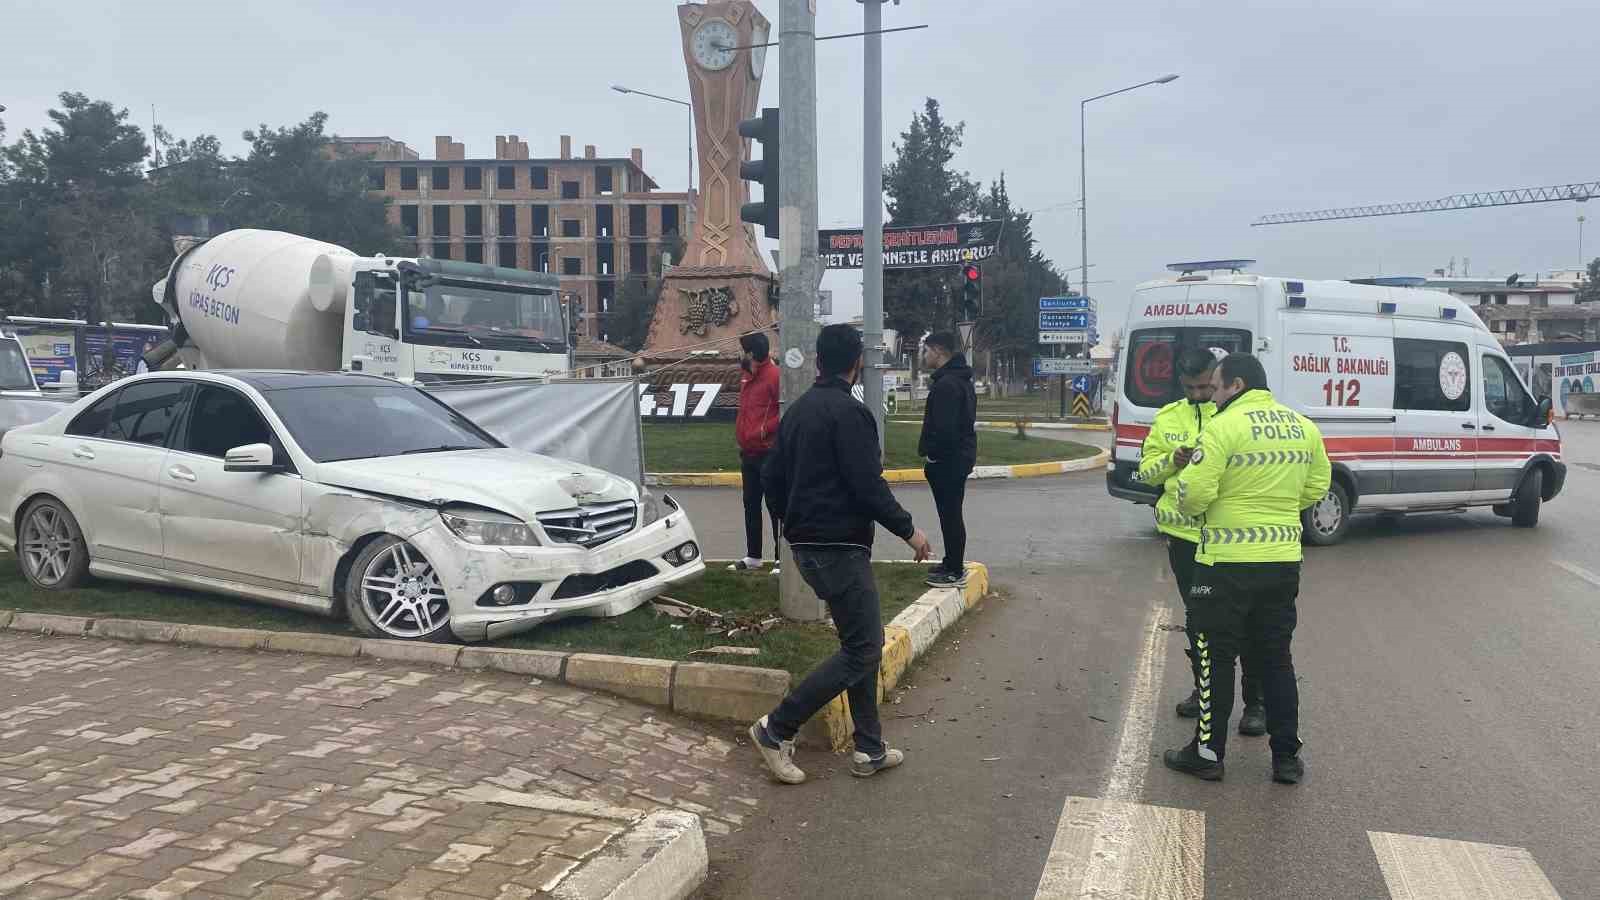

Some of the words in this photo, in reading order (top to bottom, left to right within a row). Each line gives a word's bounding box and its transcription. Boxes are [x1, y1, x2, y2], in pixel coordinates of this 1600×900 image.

[882, 250, 928, 265] NNETLE
[206, 264, 235, 291] KÇS
[210, 299, 240, 325] BETON
[1144, 303, 1228, 317] AMBULANS
[1333, 337, 1352, 352] T.C.
[462, 351, 481, 362] KÇS
[1293, 353, 1331, 373] SAĞLIK
[1337, 357, 1389, 376] BAKANLIĞI
[1322, 379, 1361, 407] 112
[1244, 410, 1302, 425] TRAFİK
[1251, 424, 1306, 440] POLİSİ
[1413, 439, 1461, 451] AMBULANS
